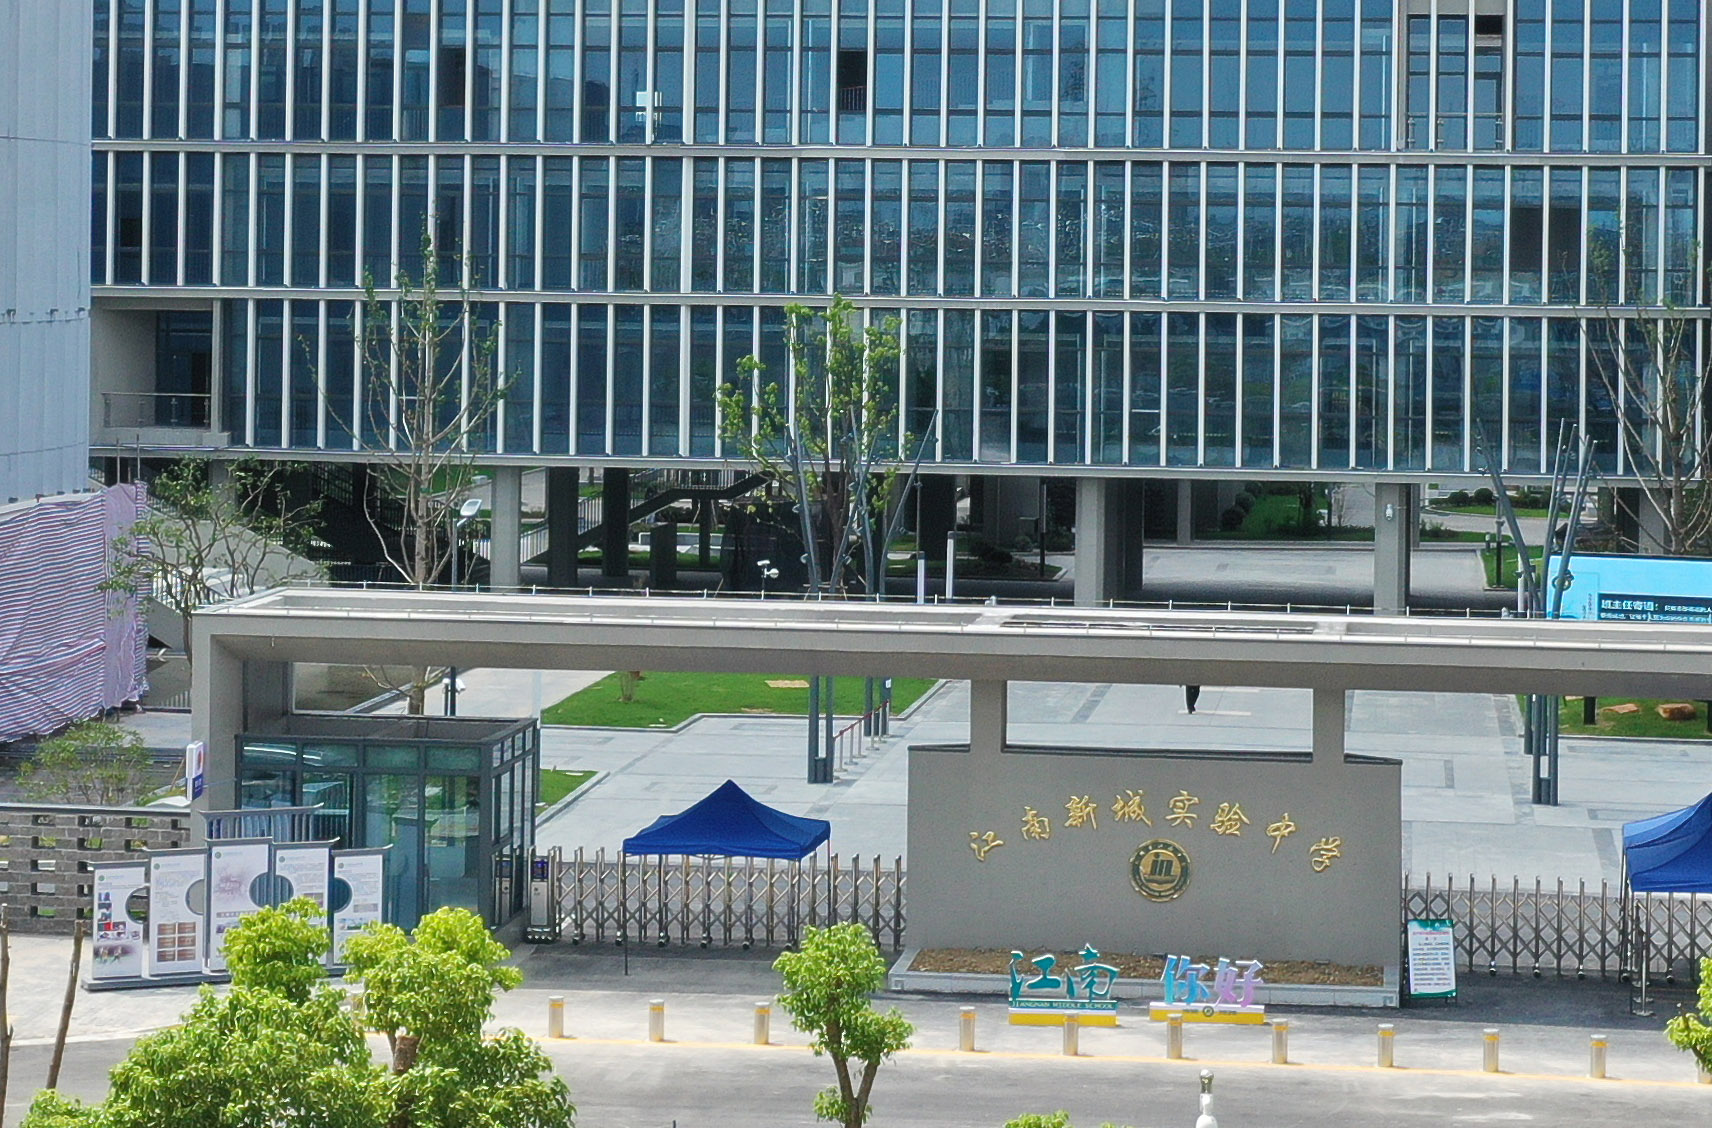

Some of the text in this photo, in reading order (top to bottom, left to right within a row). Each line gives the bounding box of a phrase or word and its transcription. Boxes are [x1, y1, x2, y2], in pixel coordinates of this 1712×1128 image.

[968, 789, 1345, 872] 江南新城实验中学
[1009, 943, 1121, 1000] 江南
[1160, 954, 1264, 1007] 你好
[1011, 1000, 1050, 1008] JIANGNAN
